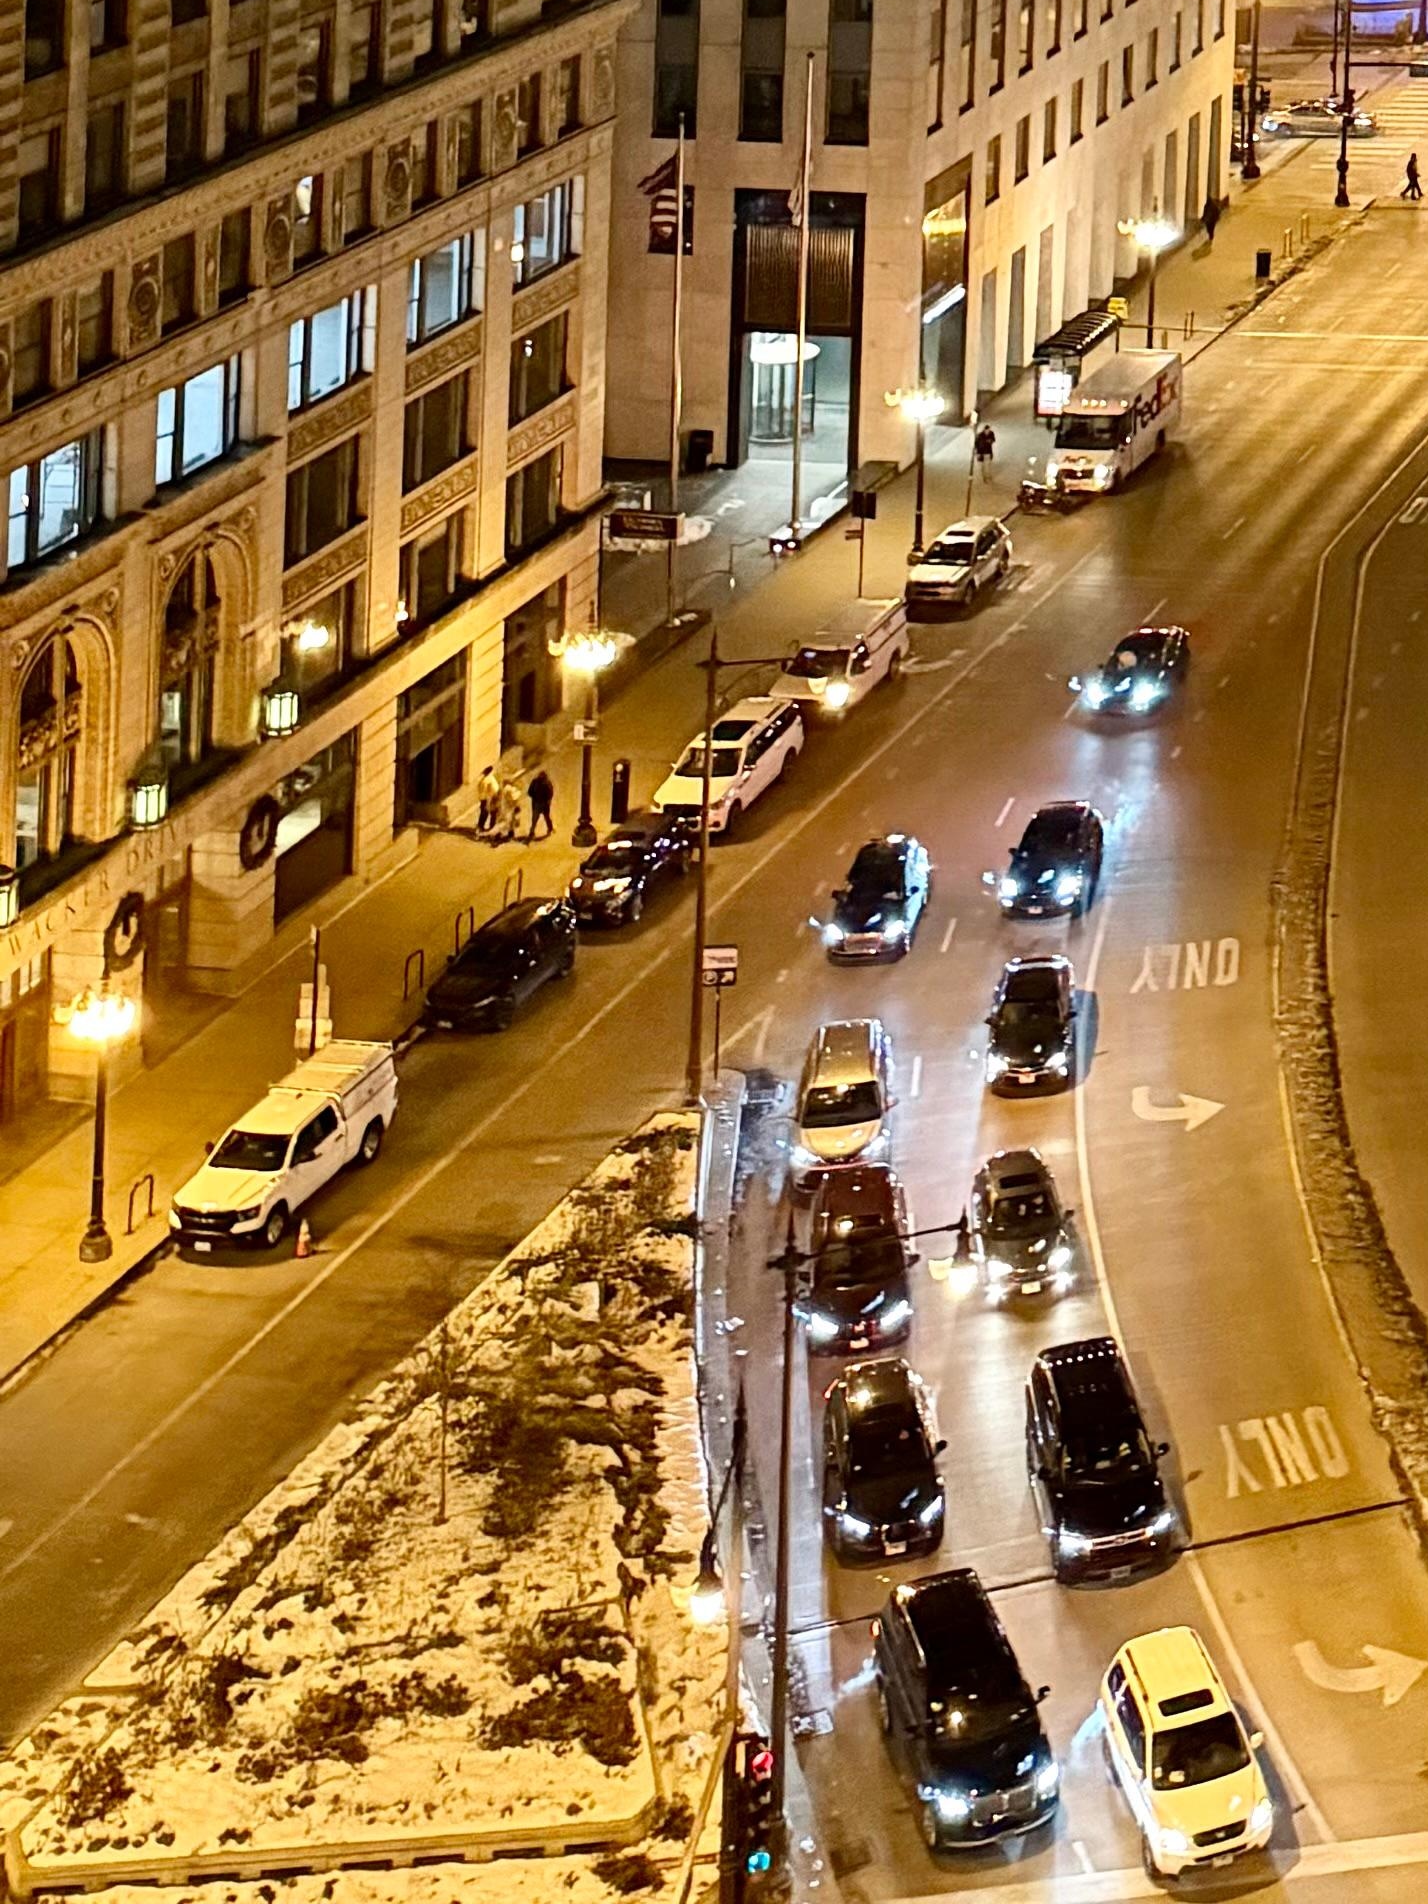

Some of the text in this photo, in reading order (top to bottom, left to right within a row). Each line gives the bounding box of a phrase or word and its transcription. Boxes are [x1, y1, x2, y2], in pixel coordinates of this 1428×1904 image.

[1132, 373, 1178, 436] FedEx
[1129, 937, 1239, 994] ONLY
[1219, 1405, 1349, 1499] ONLY
